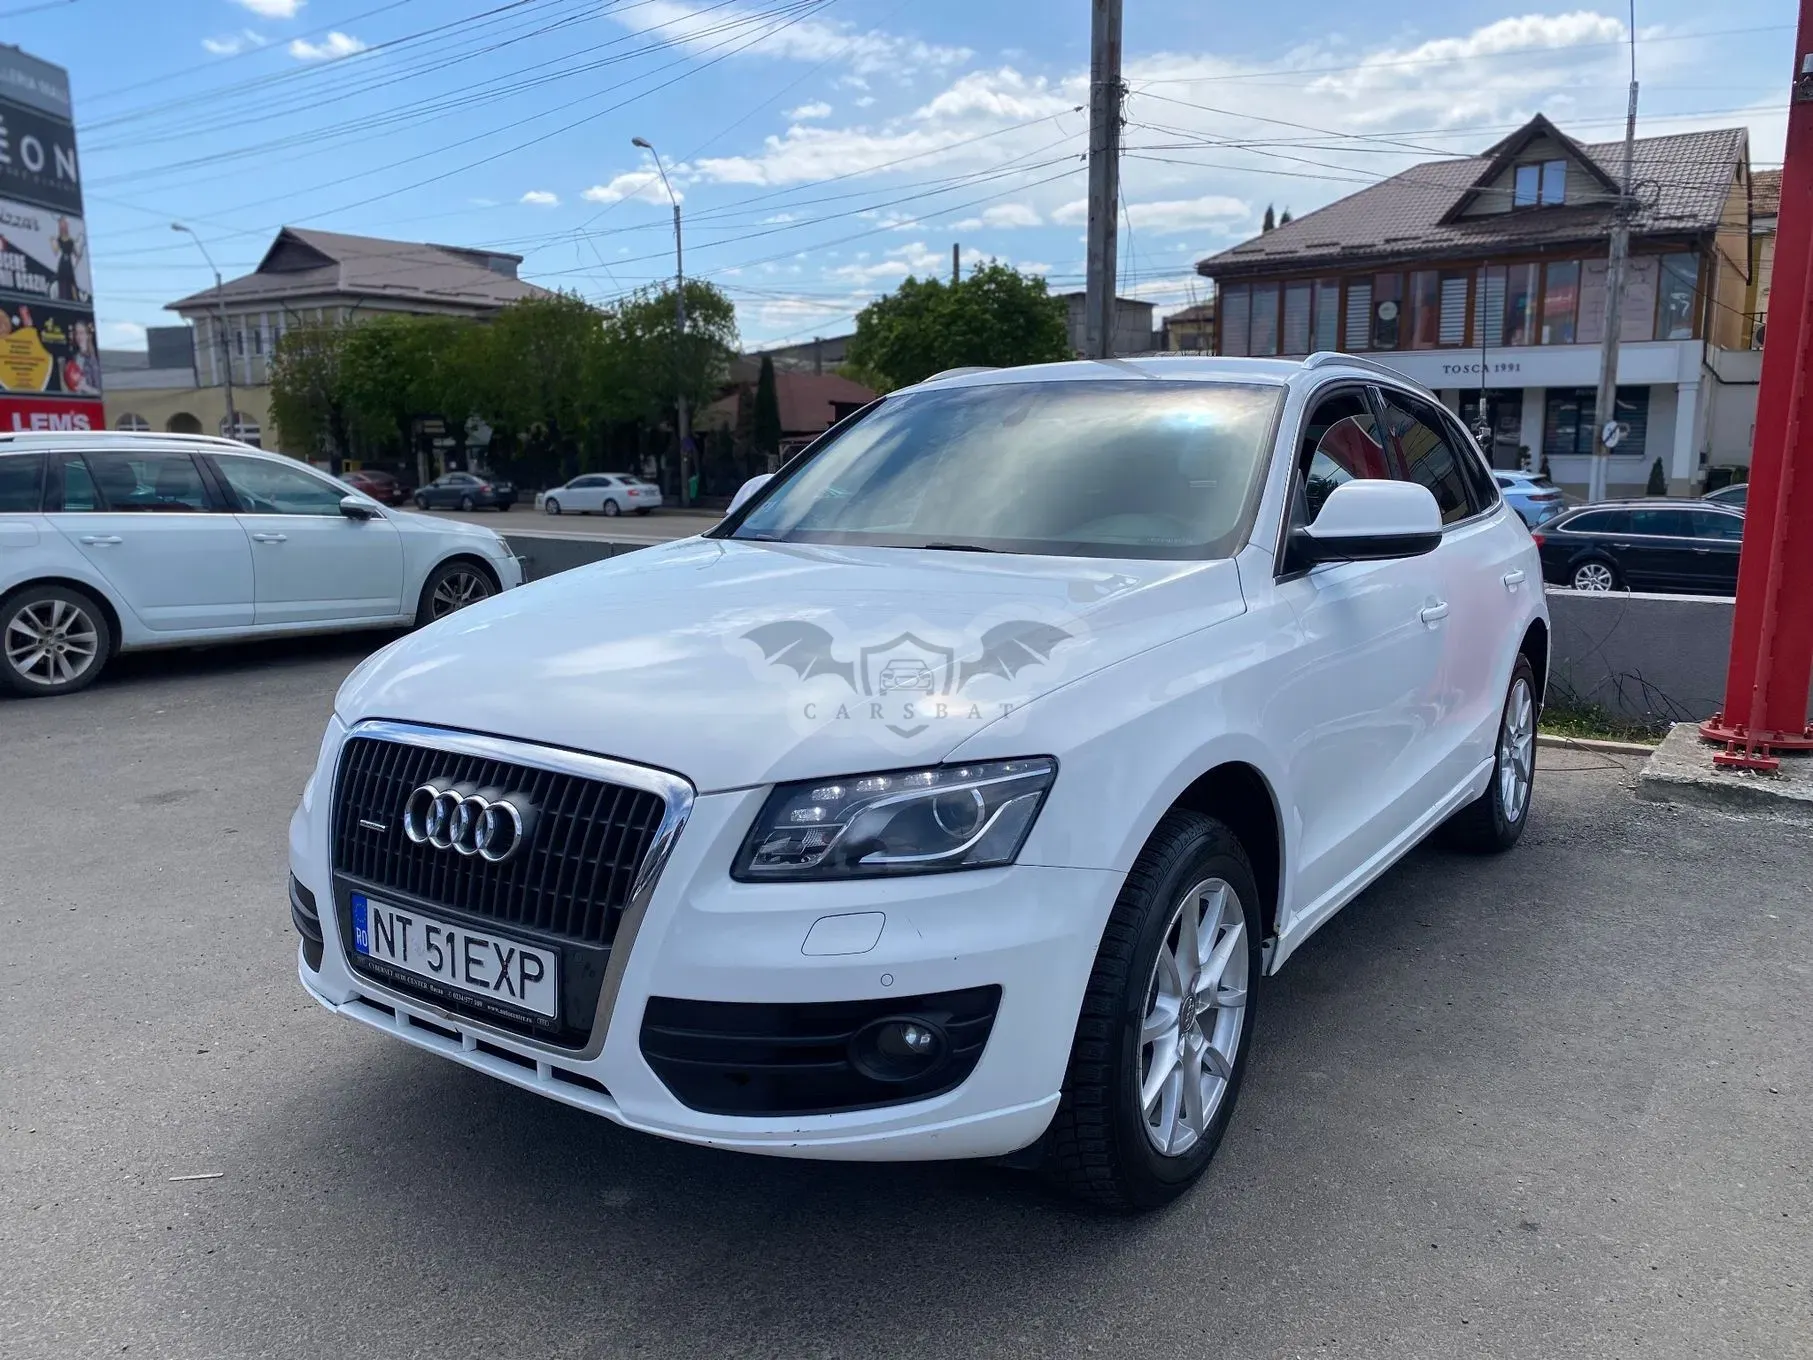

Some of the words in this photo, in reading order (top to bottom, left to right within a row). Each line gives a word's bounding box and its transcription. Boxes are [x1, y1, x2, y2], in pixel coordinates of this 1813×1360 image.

[1443, 364, 1489, 374] TOSCA
[1494, 363, 1521, 373] 1991
[356, 927, 368, 947] RO
[373, 907, 412, 962] NT
